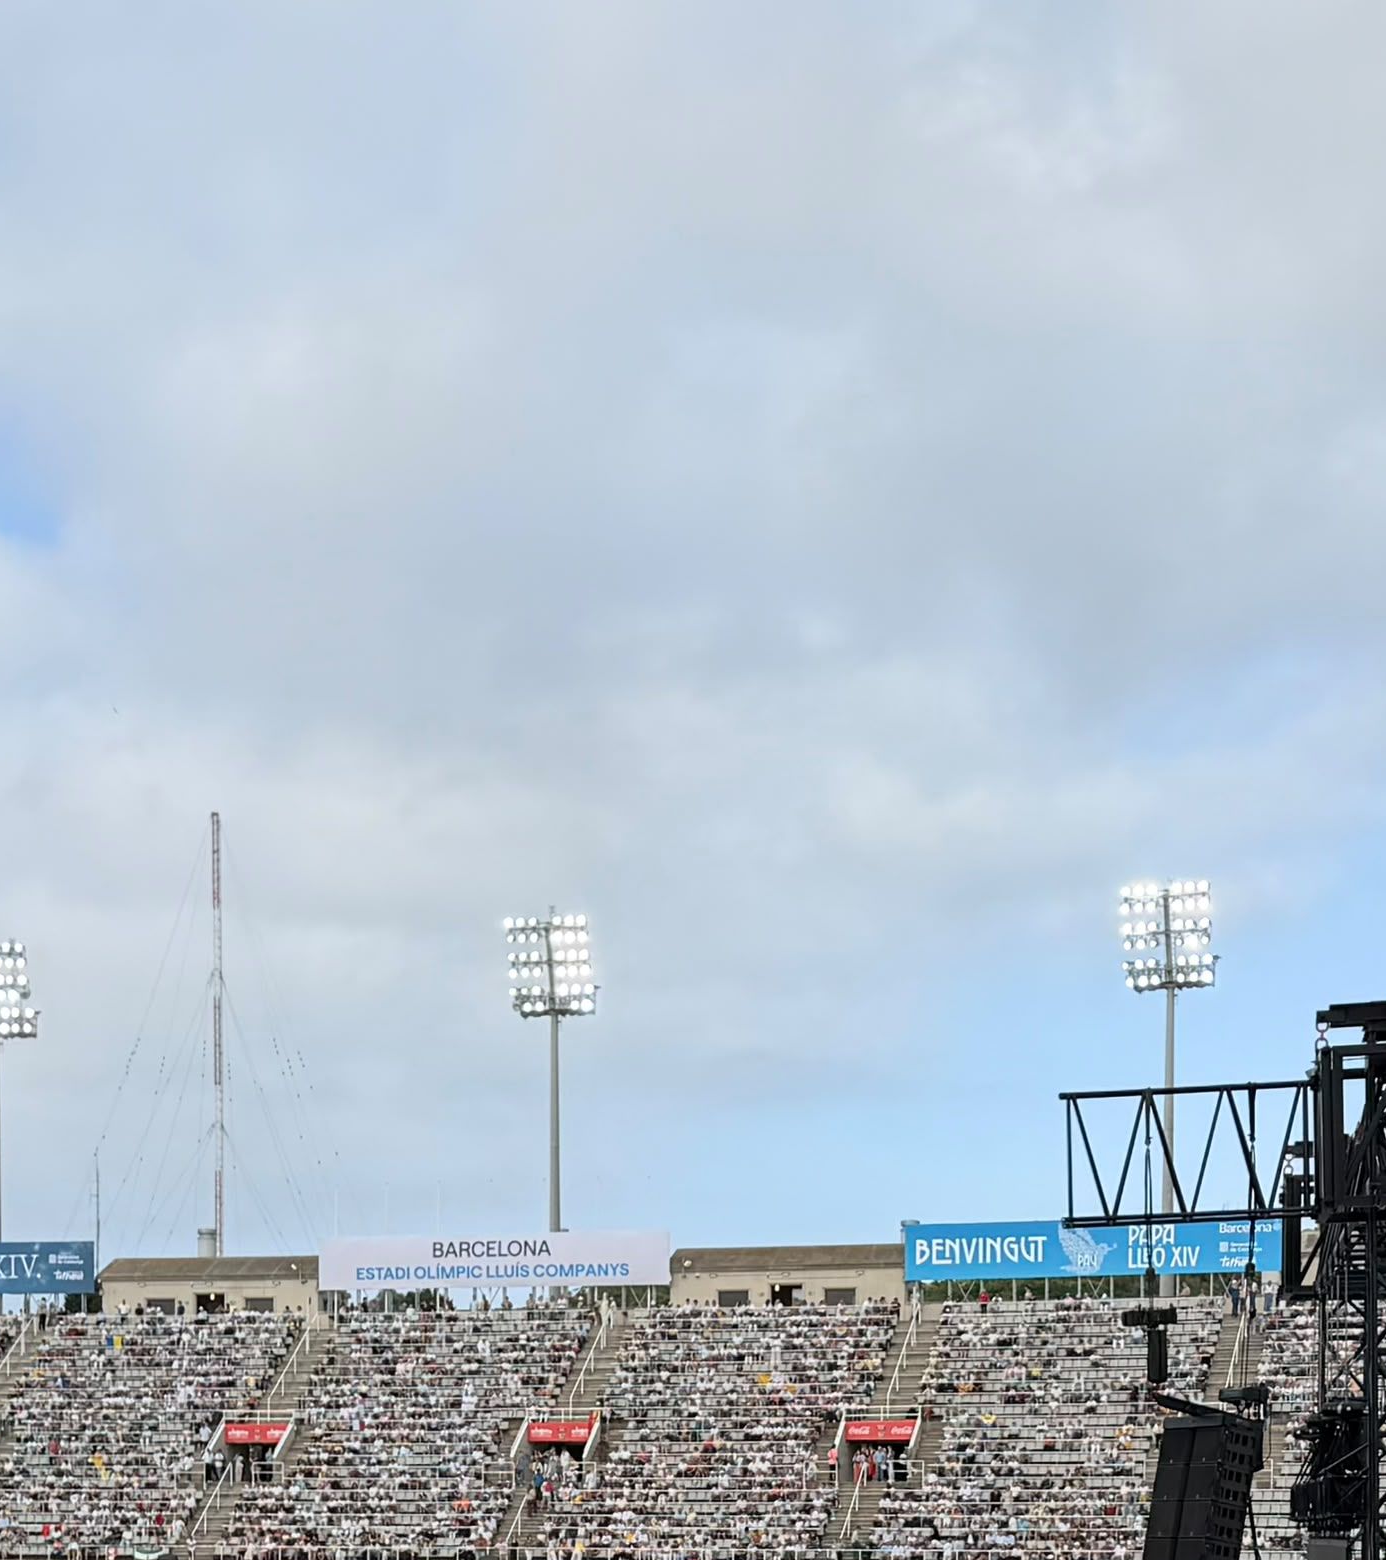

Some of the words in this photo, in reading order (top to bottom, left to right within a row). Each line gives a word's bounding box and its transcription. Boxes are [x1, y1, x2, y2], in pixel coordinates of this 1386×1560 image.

[432, 1240, 551, 1258] BARCELONA
[915, 1236, 1047, 1265] BENVINGUT
[1170, 1246, 1201, 1268] XIV
[356, 1265, 410, 1280] ESTADI
[413, 1262, 483, 1279] OLÍMPIC
[486, 1261, 530, 1278] LLUÍS
[533, 1263, 630, 1278] COMPANYS
